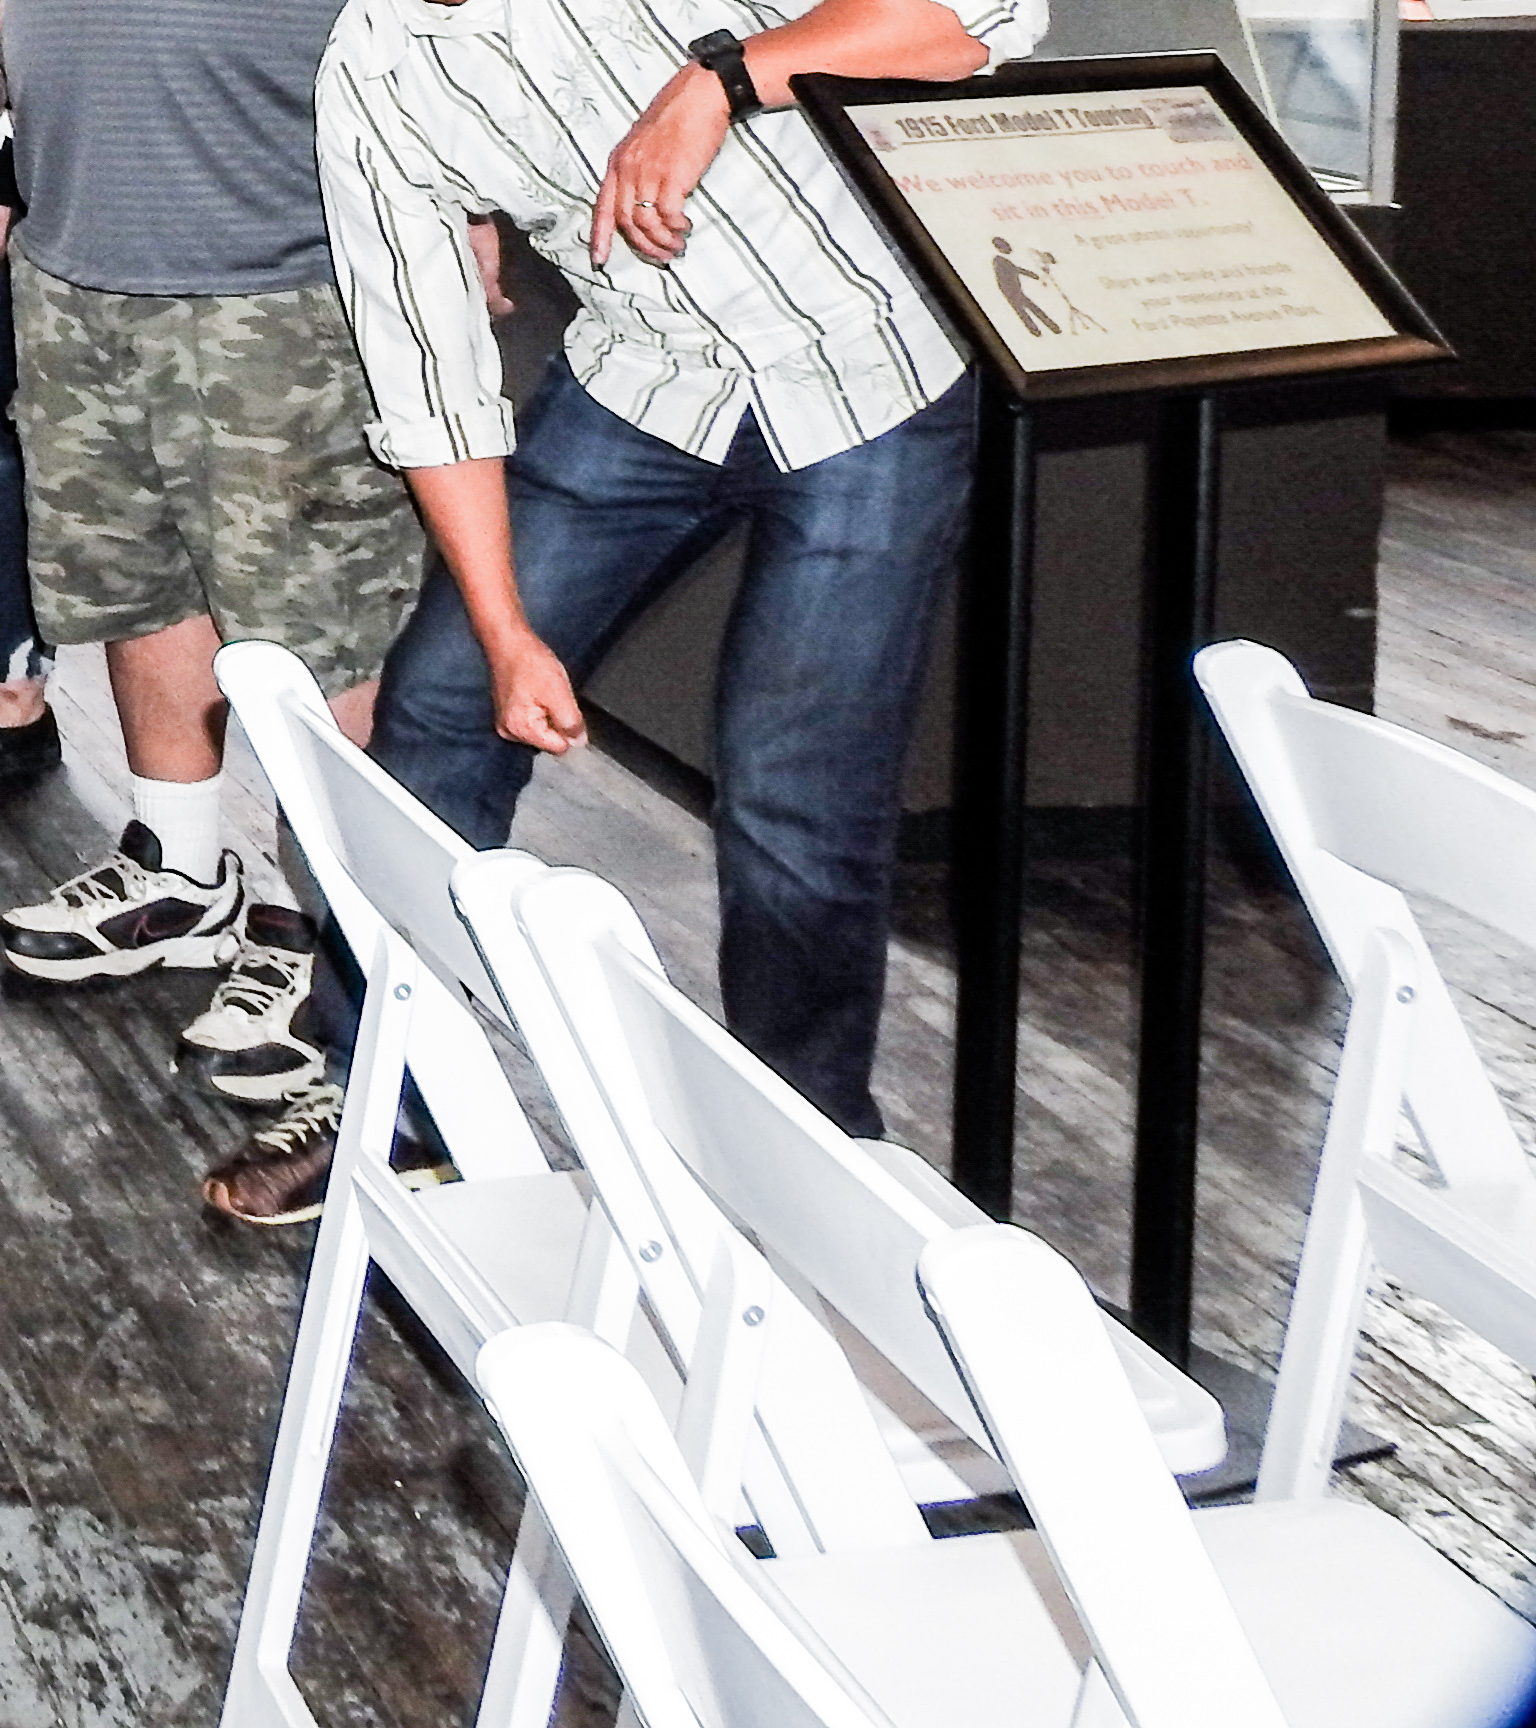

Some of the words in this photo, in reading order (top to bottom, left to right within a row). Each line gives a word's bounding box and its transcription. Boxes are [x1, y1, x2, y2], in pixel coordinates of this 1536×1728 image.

[896, 115, 949, 139] 1915
[944, 114, 996, 135] Ford
[991, 110, 1059, 133] Model
[1054, 108, 1073, 129] T
[1067, 105, 1157, 130] Touring
[894, 174, 942, 193] We
[945, 170, 1054, 190] welcome
[1059, 166, 1103, 189] you
[1105, 166, 1132, 181] to
[1138, 156, 1205, 178] touch
[1208, 152, 1254, 171] and
[992, 201, 1024, 220] sit
[1027, 200, 1049, 218] in
[1051, 197, 1100, 217] this
[1099, 192, 1177, 213] Model
